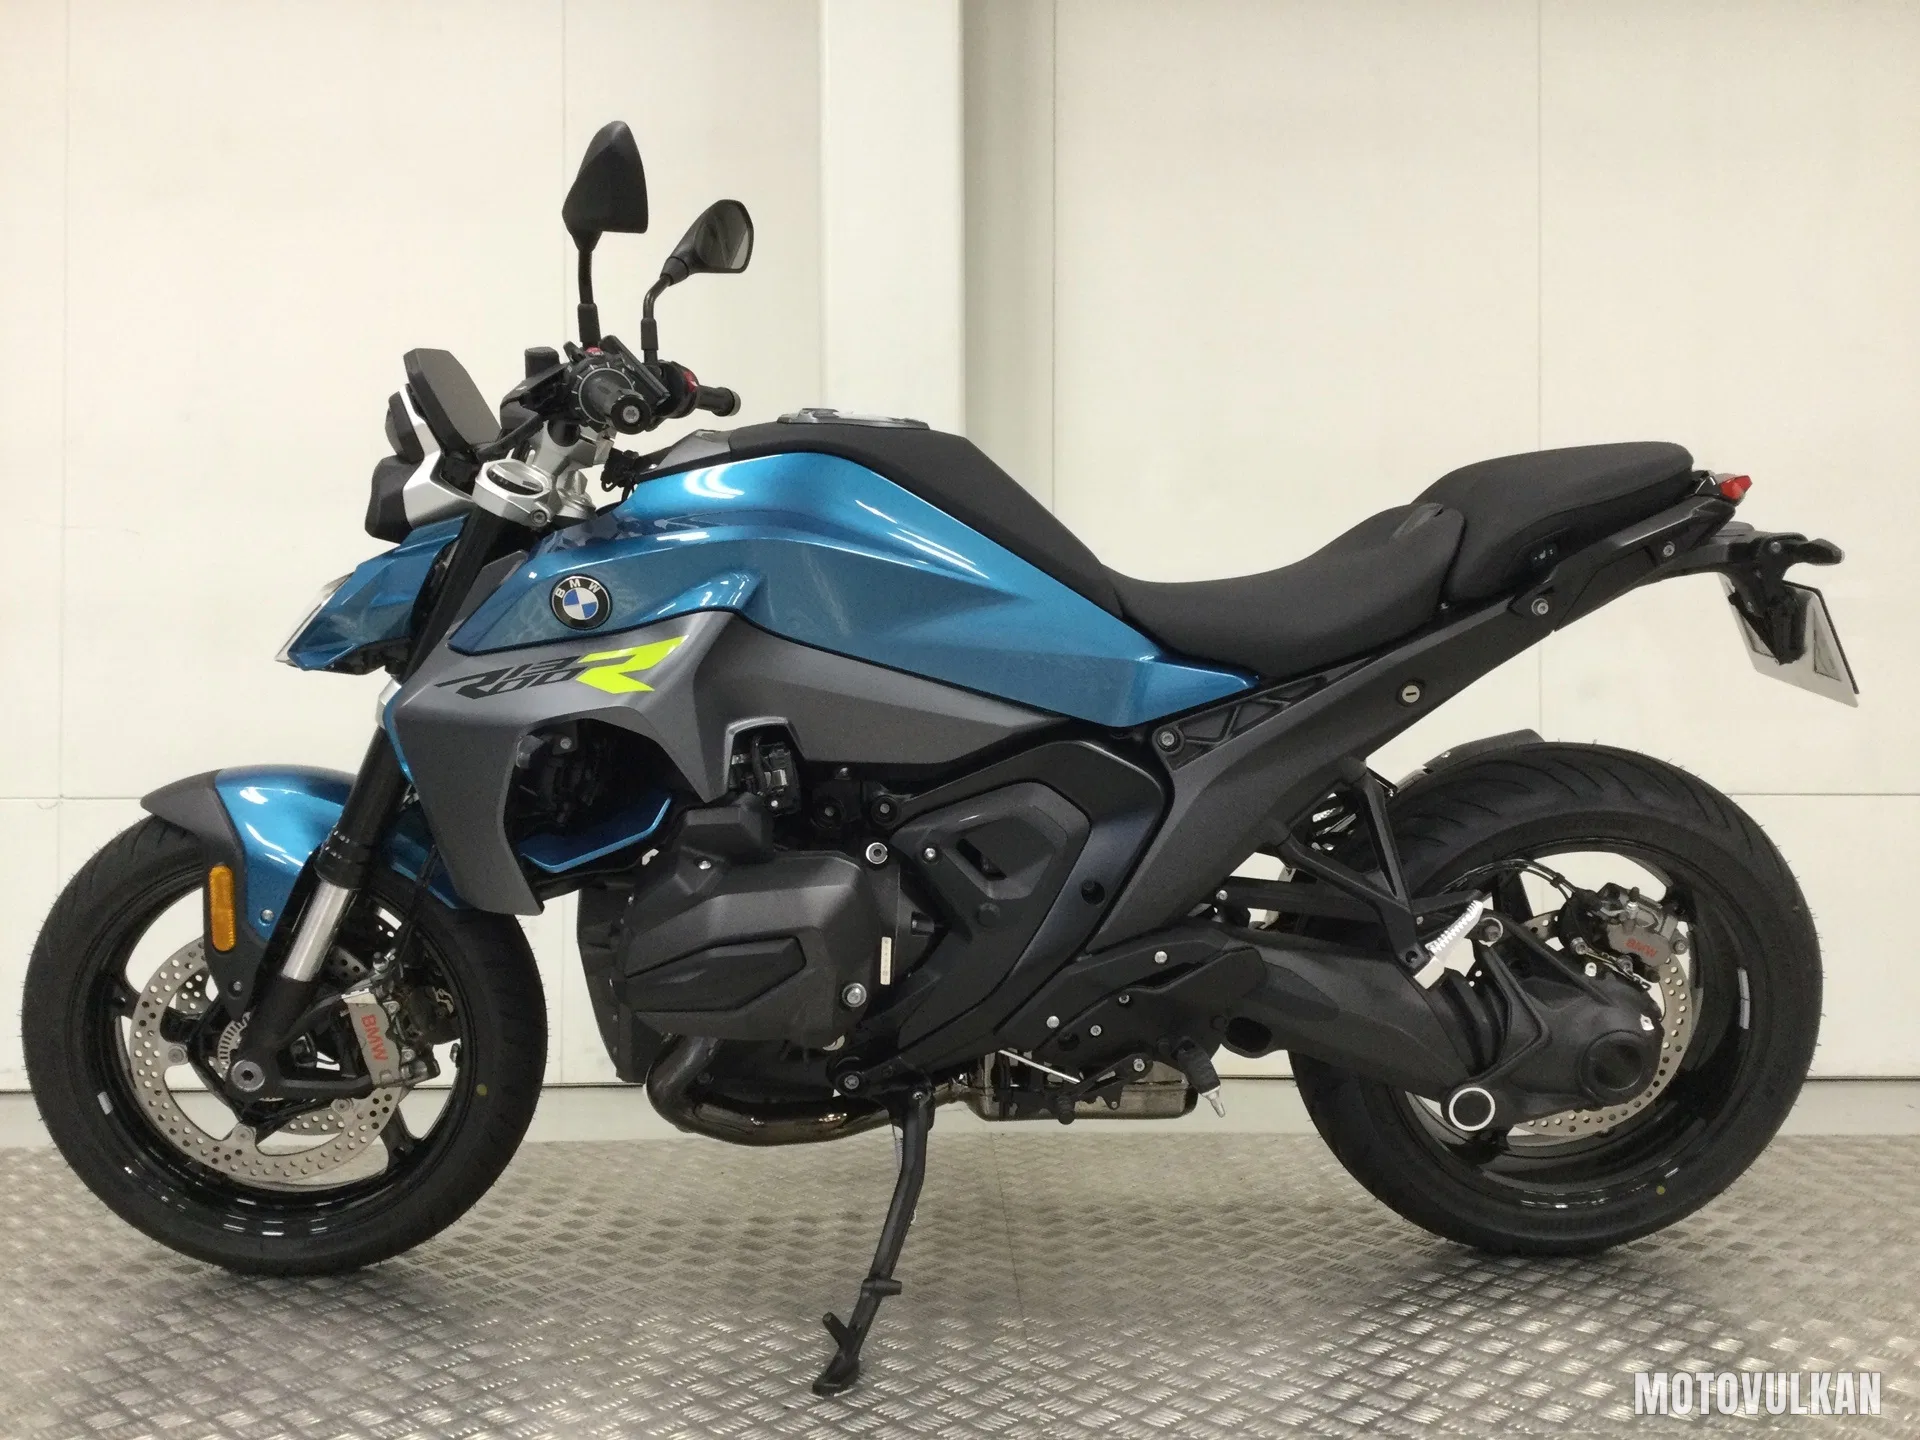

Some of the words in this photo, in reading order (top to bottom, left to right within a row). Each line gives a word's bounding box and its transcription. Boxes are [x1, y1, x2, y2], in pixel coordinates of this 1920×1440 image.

[553, 577, 602, 599] BMW
[1625, 938, 1657, 959] BMW
[361, 1014, 389, 1061] BMW
